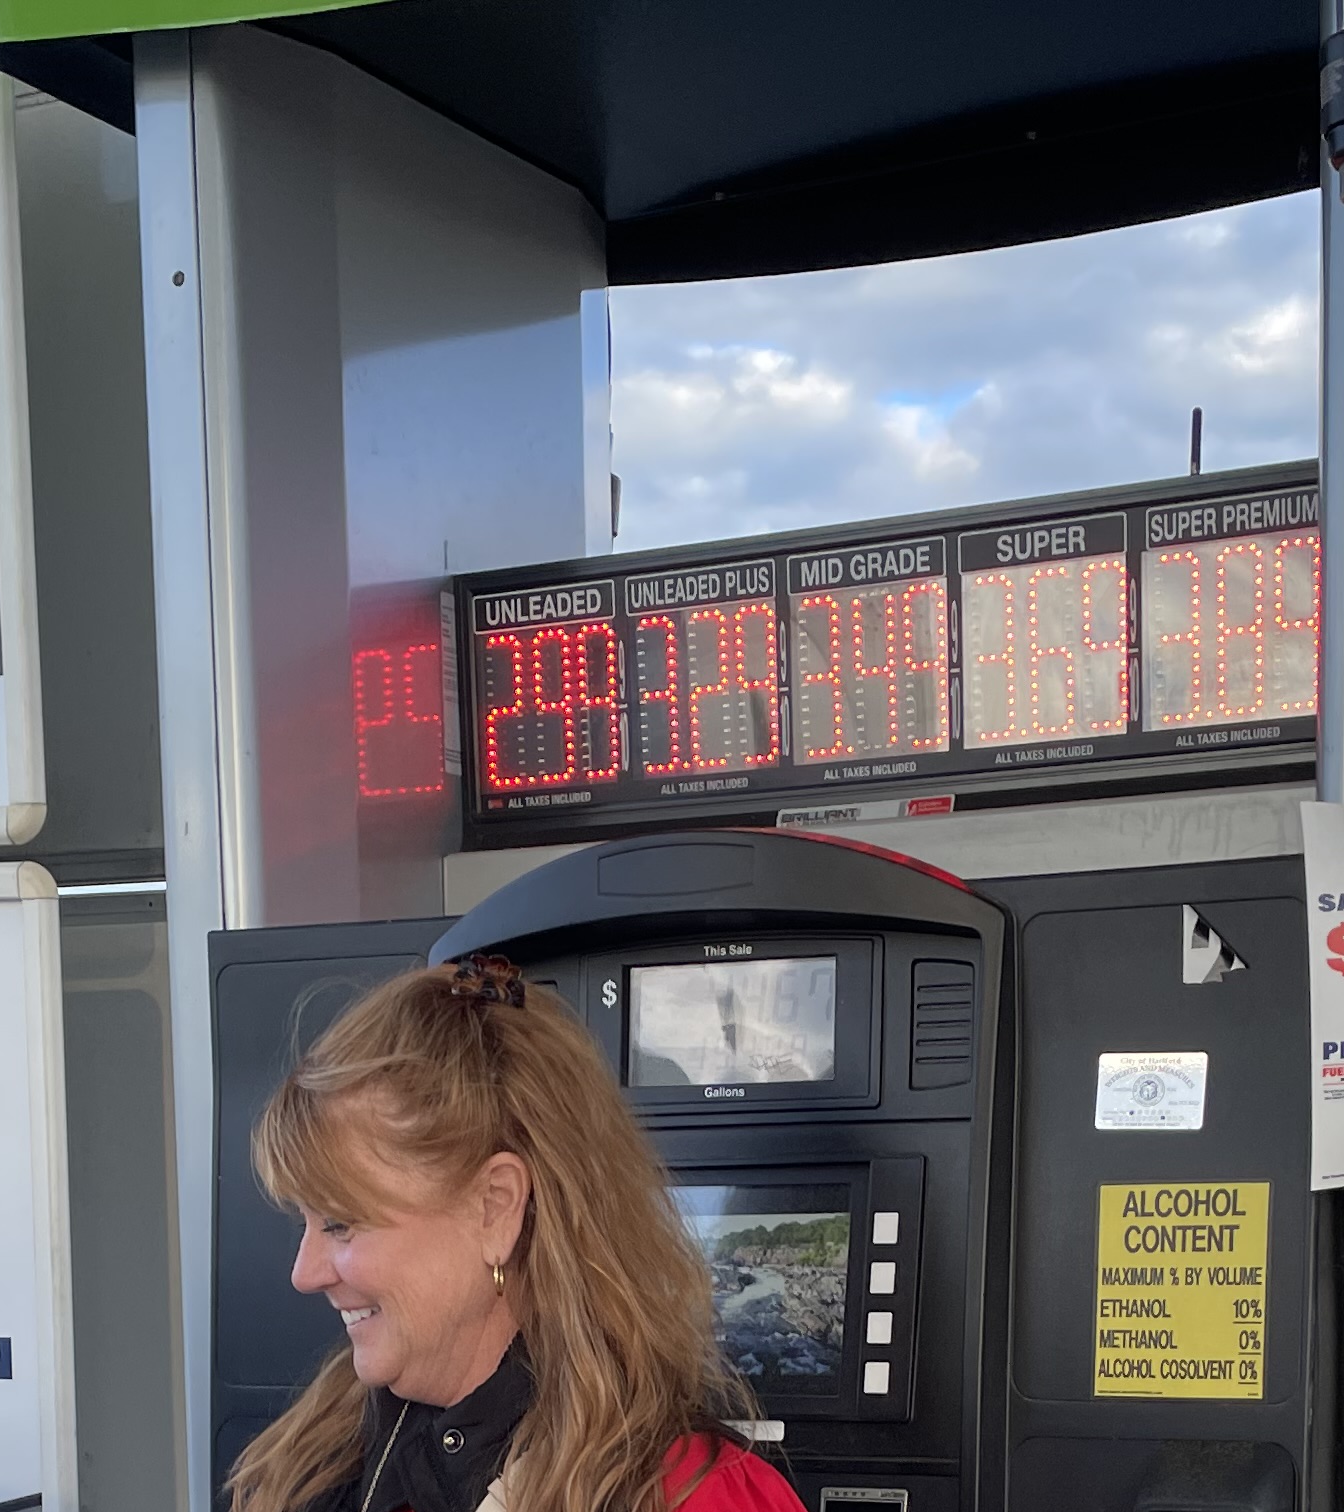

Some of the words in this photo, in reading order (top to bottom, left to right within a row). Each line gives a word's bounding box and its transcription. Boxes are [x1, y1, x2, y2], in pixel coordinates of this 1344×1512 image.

[1151, 510, 1217, 542] SUPER
[1222, 493, 1319, 531] PREMIUM
[997, 526, 1086, 561] SUPER
[800, 556, 843, 587] MID
[850, 545, 931, 582] GRADE
[630, 575, 720, 608] UNLEADED
[725, 566, 769, 598] PLUS
[485, 588, 601, 627] UNLEADED
[1176, 733, 1193, 747] ALL
[1197, 730, 1229, 746] TAXES
[1232, 726, 1280, 743] INCLUDED
[995, 748, 1012, 764] ALL
[1015, 747, 1044, 763] TAXES
[1047, 744, 1094, 760] INCLUDED
[824, 768, 839, 781] ALL
[841, 766, 868, 779] TAXES
[871, 761, 917, 776] INCLUDED
[661, 781, 677, 795] ALL
[679, 780, 704, 793] TAXES
[706, 777, 749, 791] INCLUDED
[508, 796, 521, 809] ALL
[524, 794, 550, 808] TAXES
[553, 791, 591, 805] INCLUDED
[703, 945, 726, 957] This
[728, 943, 753, 956] Sale
[601, 979, 617, 1009] $
[703, 1086, 745, 1099] Gallons
[1123, 1188, 1246, 1218] ALCOHOL
[1124, 1225, 1240, 1253] CONTENT
[1101, 1266, 1164, 1287] MAXIMUM
[1169, 1267, 1180, 1286] %
[1184, 1267, 1202, 1286] BY
[1207, 1266, 1263, 1286] VOLUME
[1100, 1299, 1171, 1319] ETHANOL
[1232, 1299, 1263, 1319] 10%
[1099, 1330, 1178, 1350] METHANOL
[1238, 1330, 1261, 1350] 0%
[1098, 1359, 1156, 1380] ALCOHOL
[1160, 1359, 1234, 1380] COSOLVENT
[1238, 1360, 1258, 1380] 0%
